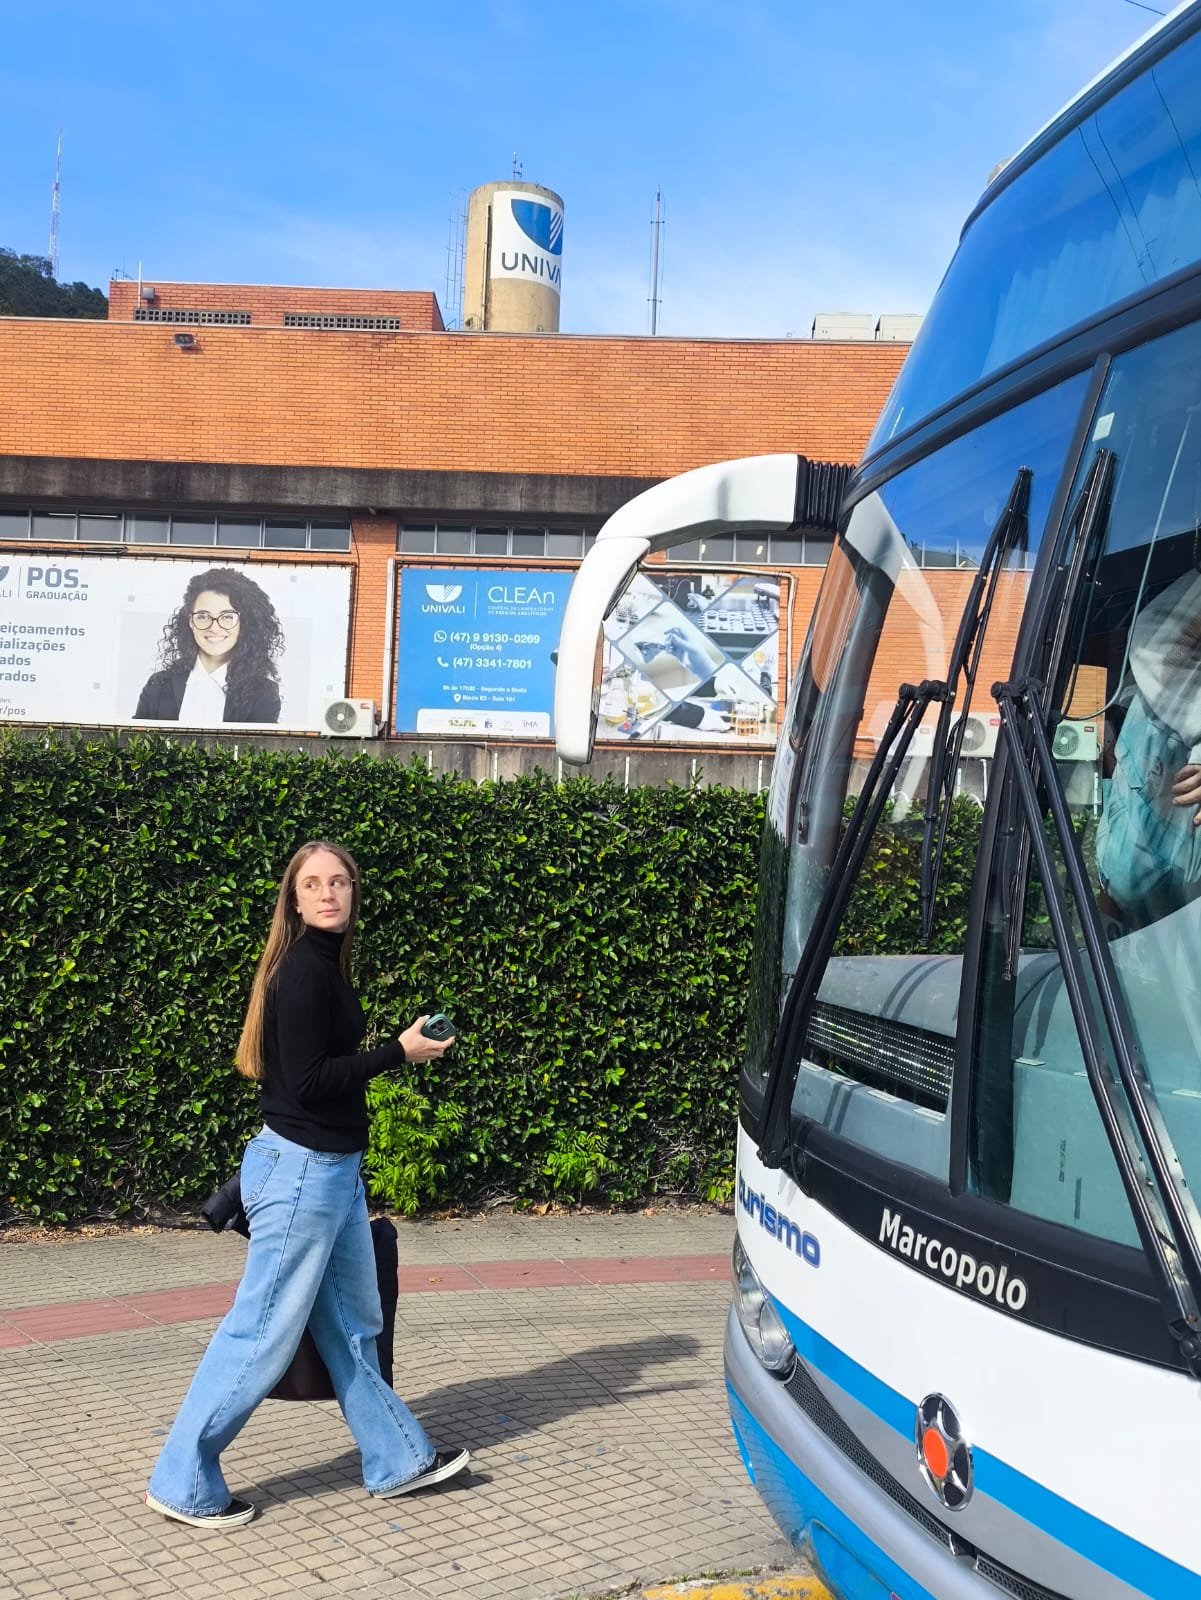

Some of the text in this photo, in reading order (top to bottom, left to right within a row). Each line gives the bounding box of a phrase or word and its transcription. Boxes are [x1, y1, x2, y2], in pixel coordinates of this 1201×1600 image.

[26, 590, 88, 602] GRADUAÇÃO
[487, 586, 555, 604] CLEAn
[421, 604, 466, 614] UNIVALI
[450, 632, 541, 644] (47) 9 9130-0269
[453, 657, 532, 669] (47) 3341-7801
[879, 1207, 1027, 1310] Marcopolo
